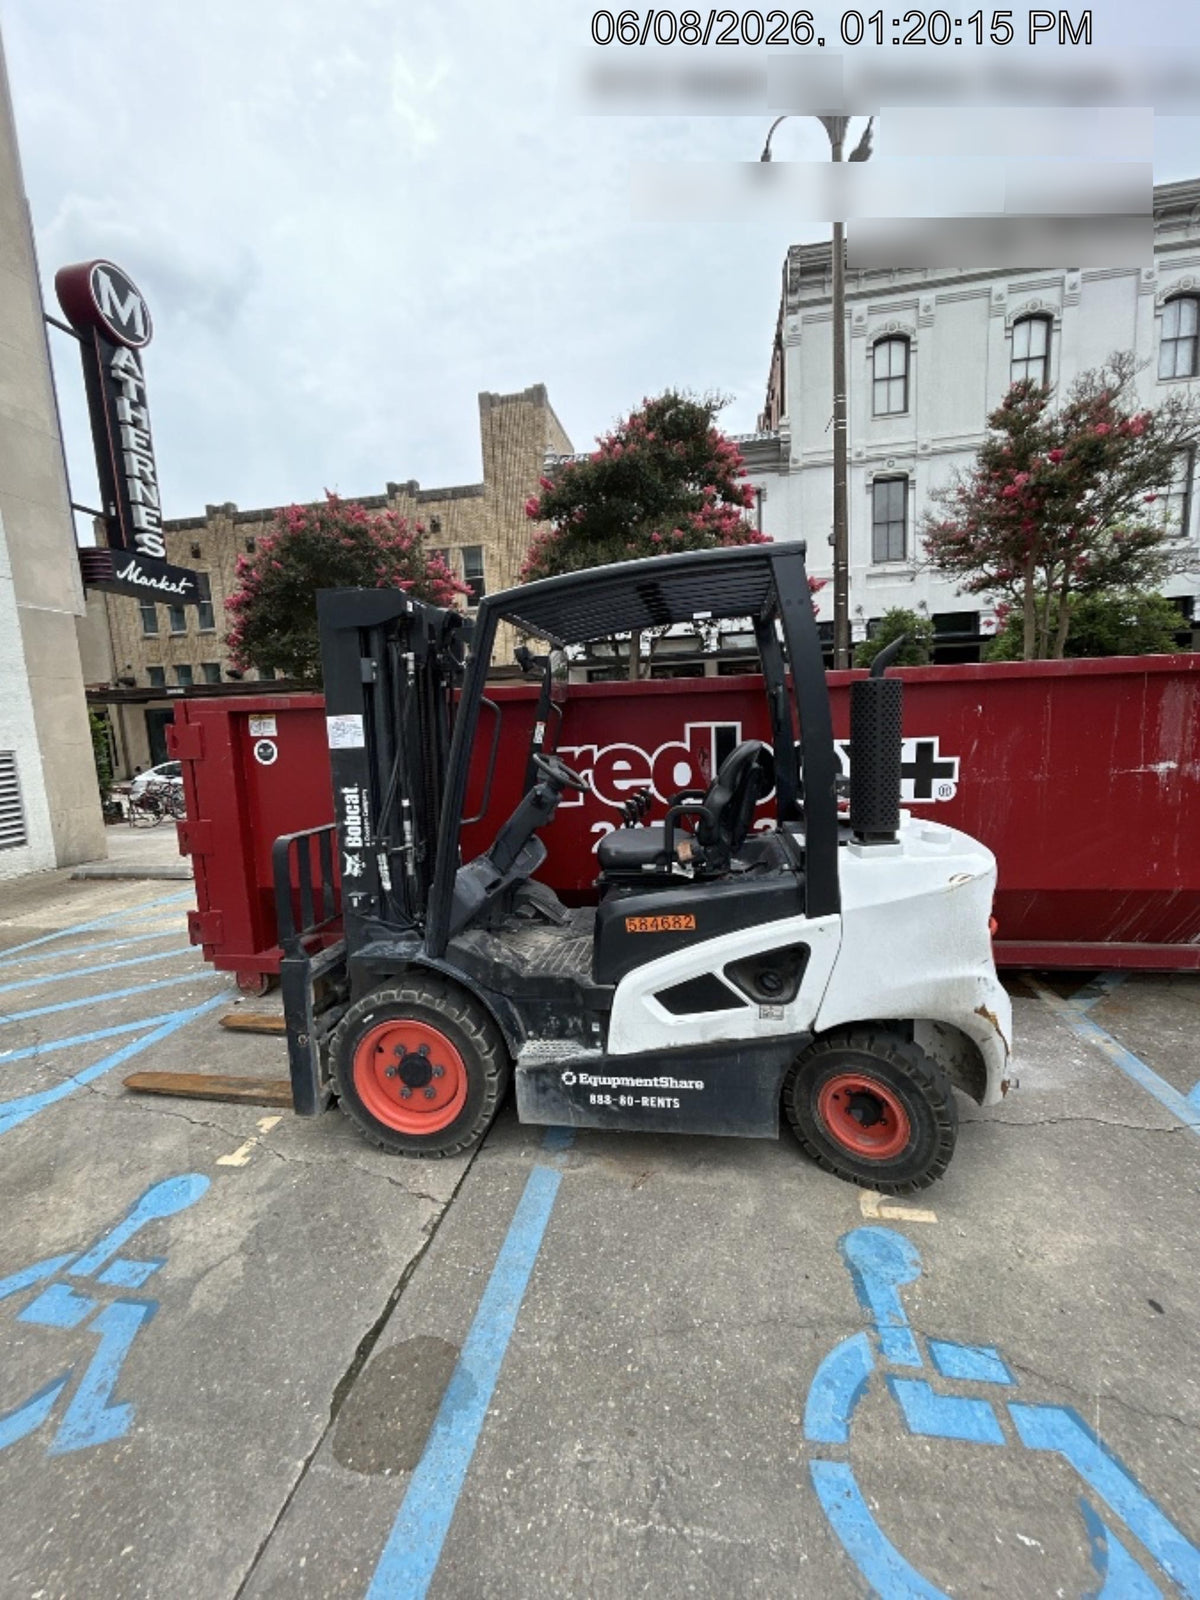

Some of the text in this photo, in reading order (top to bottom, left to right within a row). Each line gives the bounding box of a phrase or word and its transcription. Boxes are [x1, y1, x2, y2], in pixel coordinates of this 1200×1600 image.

[116, 560, 194, 594] Market
[341, 786, 363, 847] Bobcat
[628, 915, 693, 931] 584682
[579, 1073, 705, 1090] EquipmentShare
